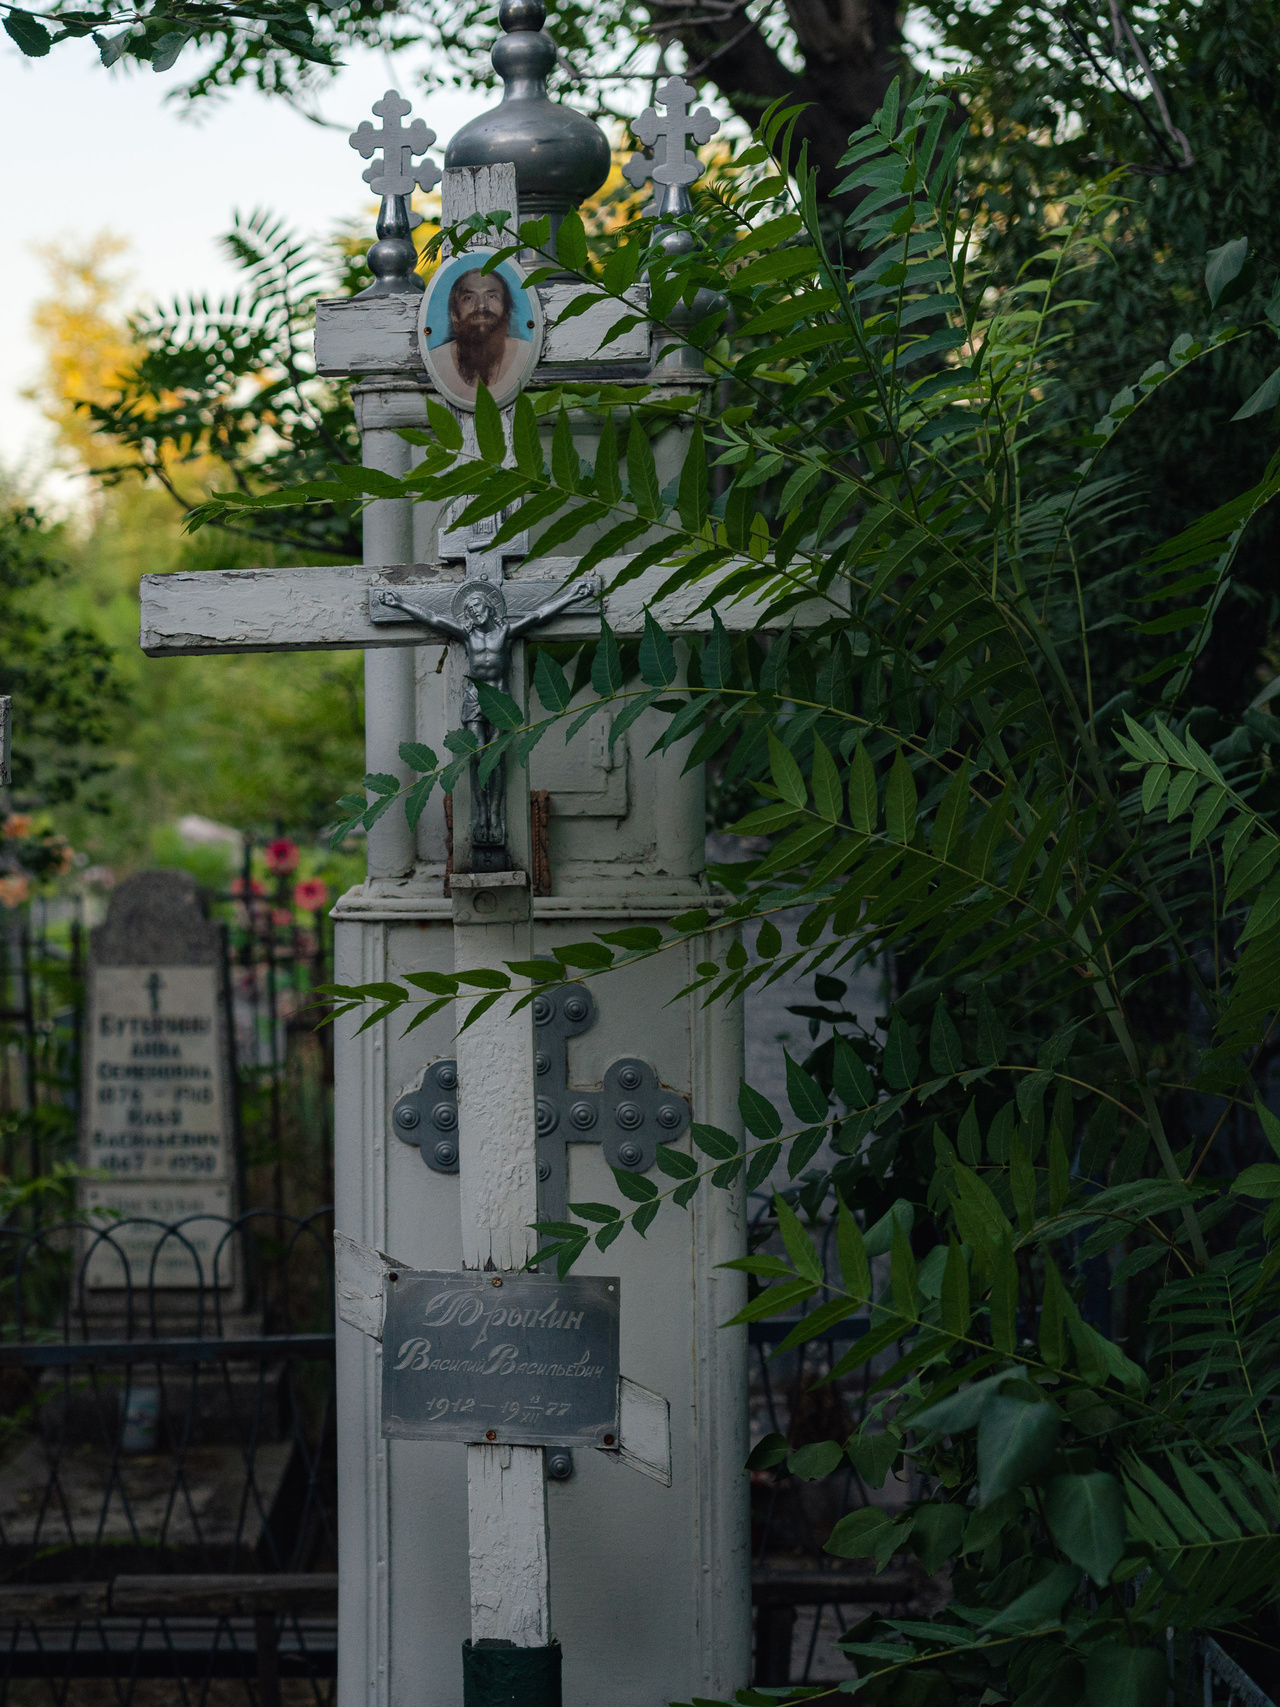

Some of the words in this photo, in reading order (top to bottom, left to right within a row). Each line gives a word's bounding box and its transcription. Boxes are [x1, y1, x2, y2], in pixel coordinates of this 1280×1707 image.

[393, 1337, 486, 1374] Василий
[482, 1344, 605, 1378] Васильевич
[426, 1397, 475, 1421] 1912
